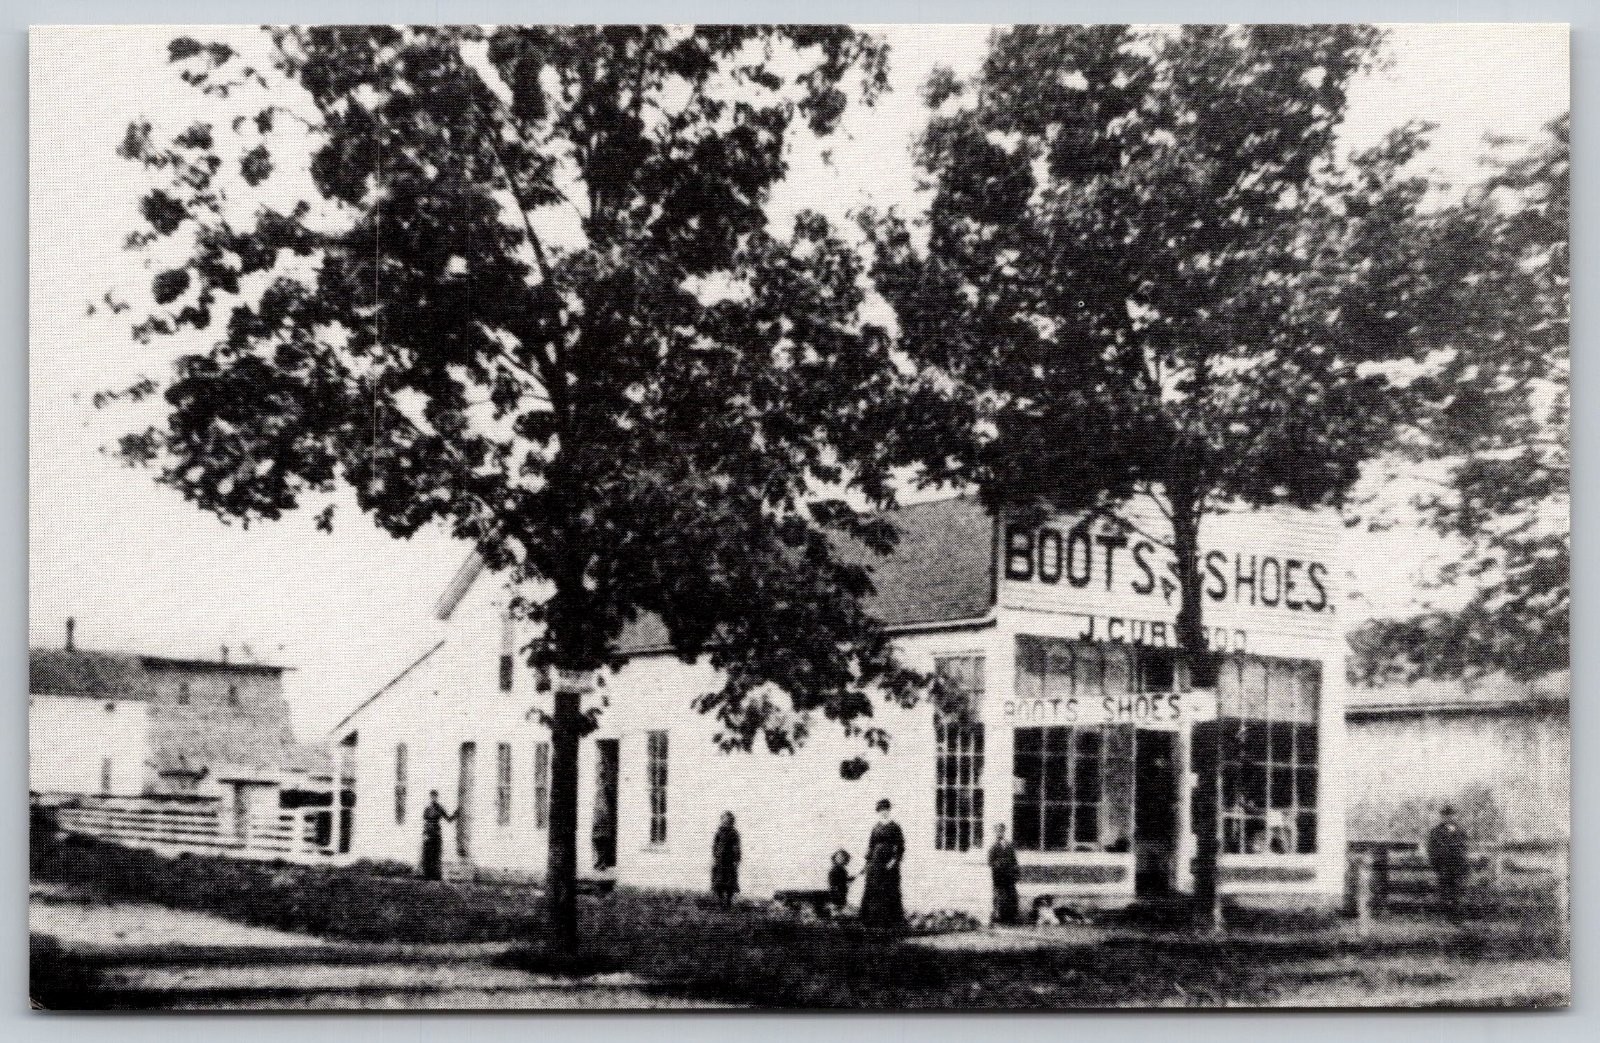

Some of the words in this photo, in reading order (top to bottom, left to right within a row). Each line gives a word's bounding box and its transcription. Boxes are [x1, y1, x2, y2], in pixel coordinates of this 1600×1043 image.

[1005, 522, 1155, 595] BOOTS
[1004, 698, 1079, 723] BOOTS
[1102, 693, 1181, 722] SHOES
